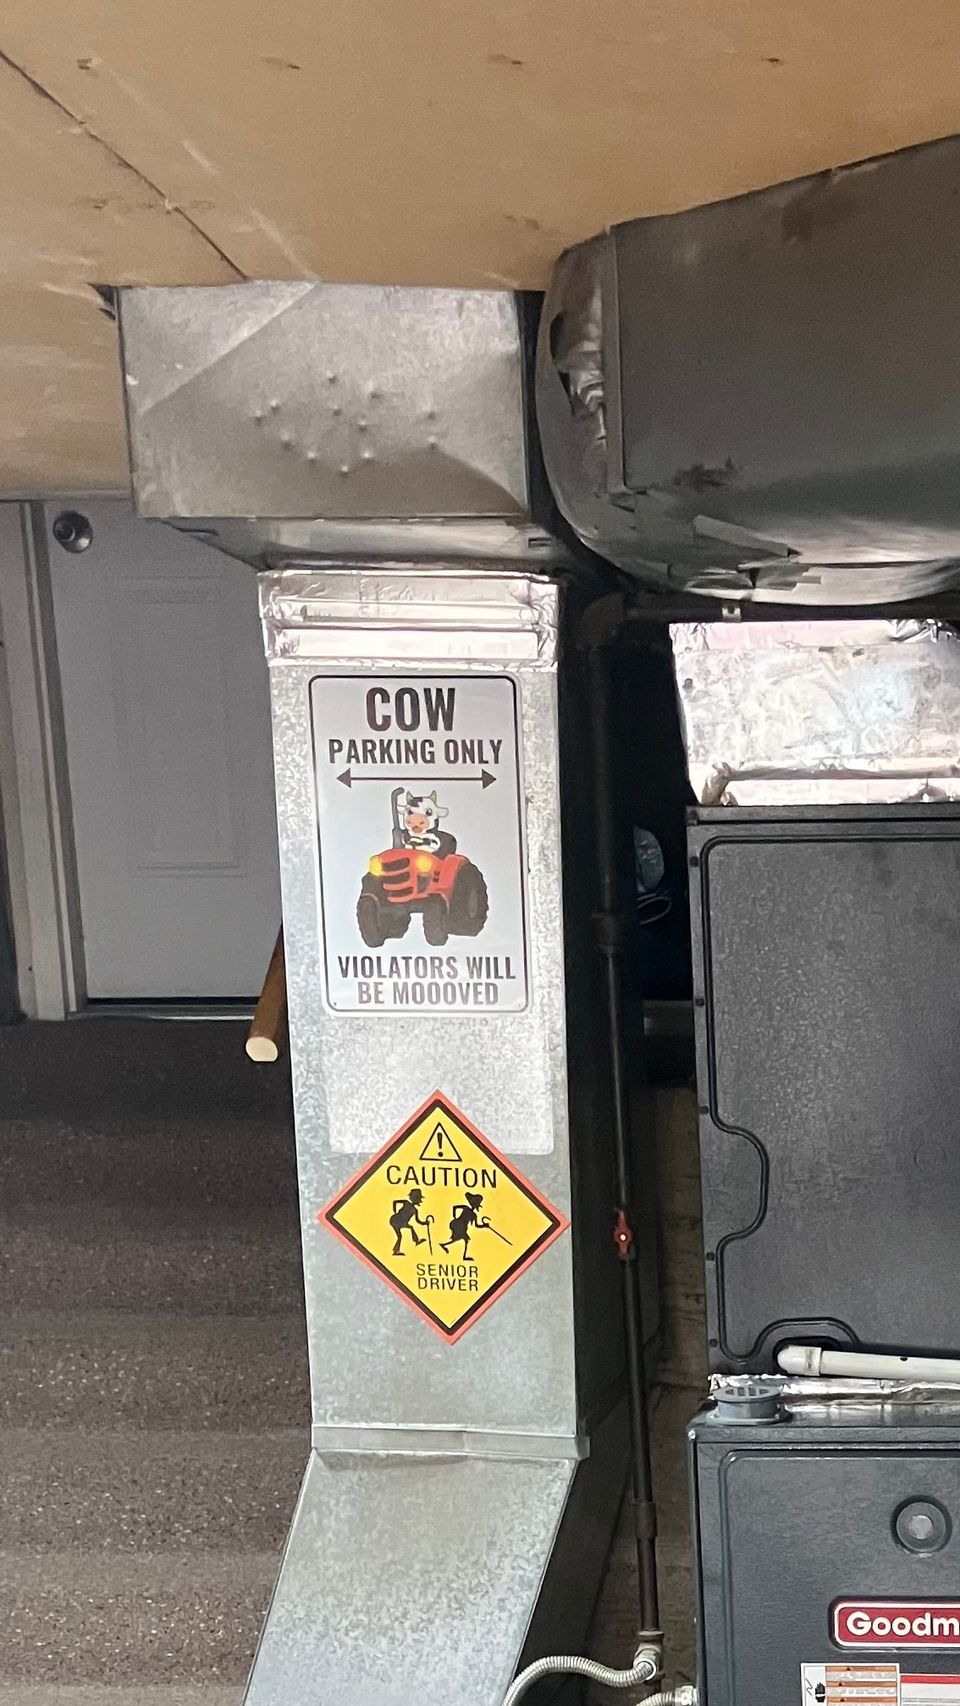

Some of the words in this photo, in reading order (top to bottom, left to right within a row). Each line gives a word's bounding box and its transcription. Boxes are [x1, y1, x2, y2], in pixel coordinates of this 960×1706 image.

[366, 687, 456, 732] COW
[329, 739, 435, 765] PARKING
[444, 739, 502, 765] ONLY
[338, 955, 458, 980] VIOLATORS
[466, 956, 516, 980] WILL
[358, 982, 384, 1005] BE
[392, 982, 499, 1006] MOOOVED
[386, 1165, 497, 1188] CAUTION
[416, 1263, 478, 1279] SENIOR
[417, 1277, 479, 1291] DRIVER
